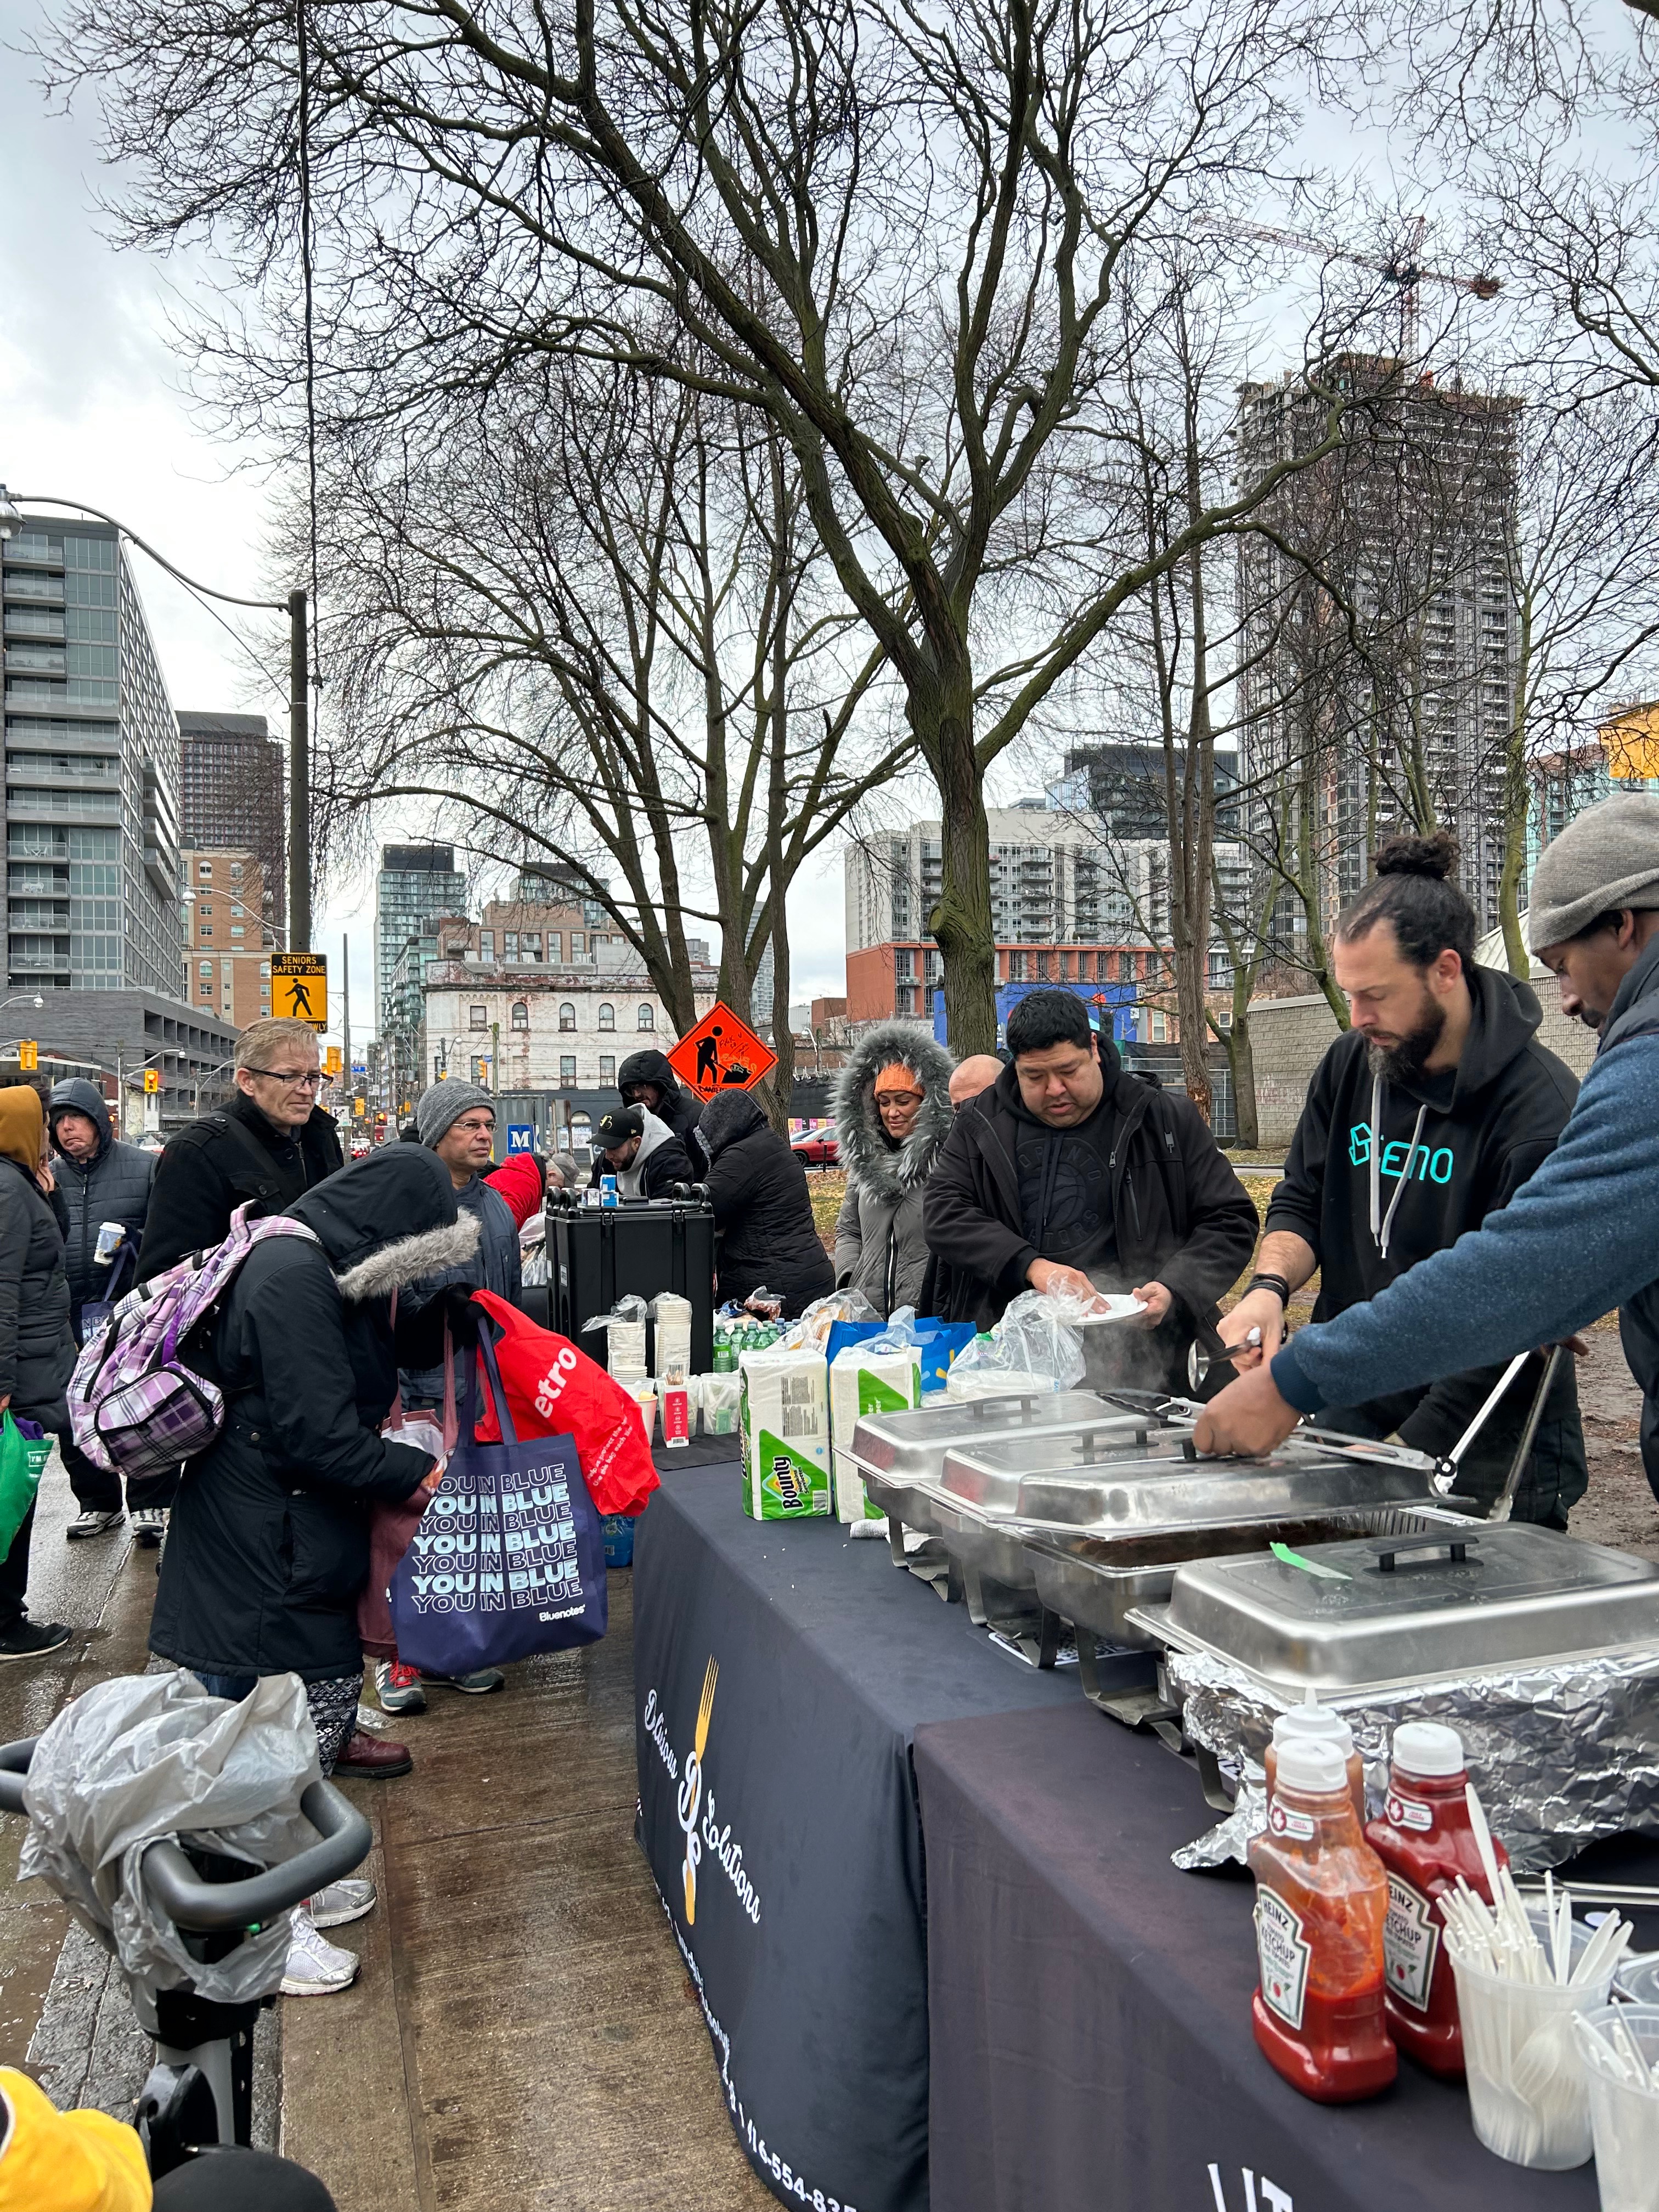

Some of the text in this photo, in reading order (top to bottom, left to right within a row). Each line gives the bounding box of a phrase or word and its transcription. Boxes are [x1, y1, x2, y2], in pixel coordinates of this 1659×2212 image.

[281, 956, 317, 964] SENIORS
[306, 966, 326, 974] ZONE
[312, 1023, 326, 1031] WLY
[535, 1347, 577, 1418] etro
[436, 1476, 476, 1494] OU
[500, 1463, 566, 1492] BLUE
[773, 1456, 804, 1510] Bounty
[501, 1481, 570, 1513] BLUE
[419, 1501, 572, 1534] YOU IN BLUE
[413, 1520, 576, 1555] YOU IN BLUE
[412, 1539, 577, 1574] YOU IN BLUE
[411, 1558, 579, 1594] YOU IN BLUE
[411, 1577, 583, 1613] YOU IN BLUE
[703, 1790, 760, 1924] Solutions
[1263, 1898, 1288, 1931] HEINZ
[1389, 1885, 1414, 1913] EINZ
[1262, 1926, 1295, 1961] KETCHUP
[1386, 1912, 1421, 1944] ETCHUP
[747, 2119, 857, 2212] 416-554-83
